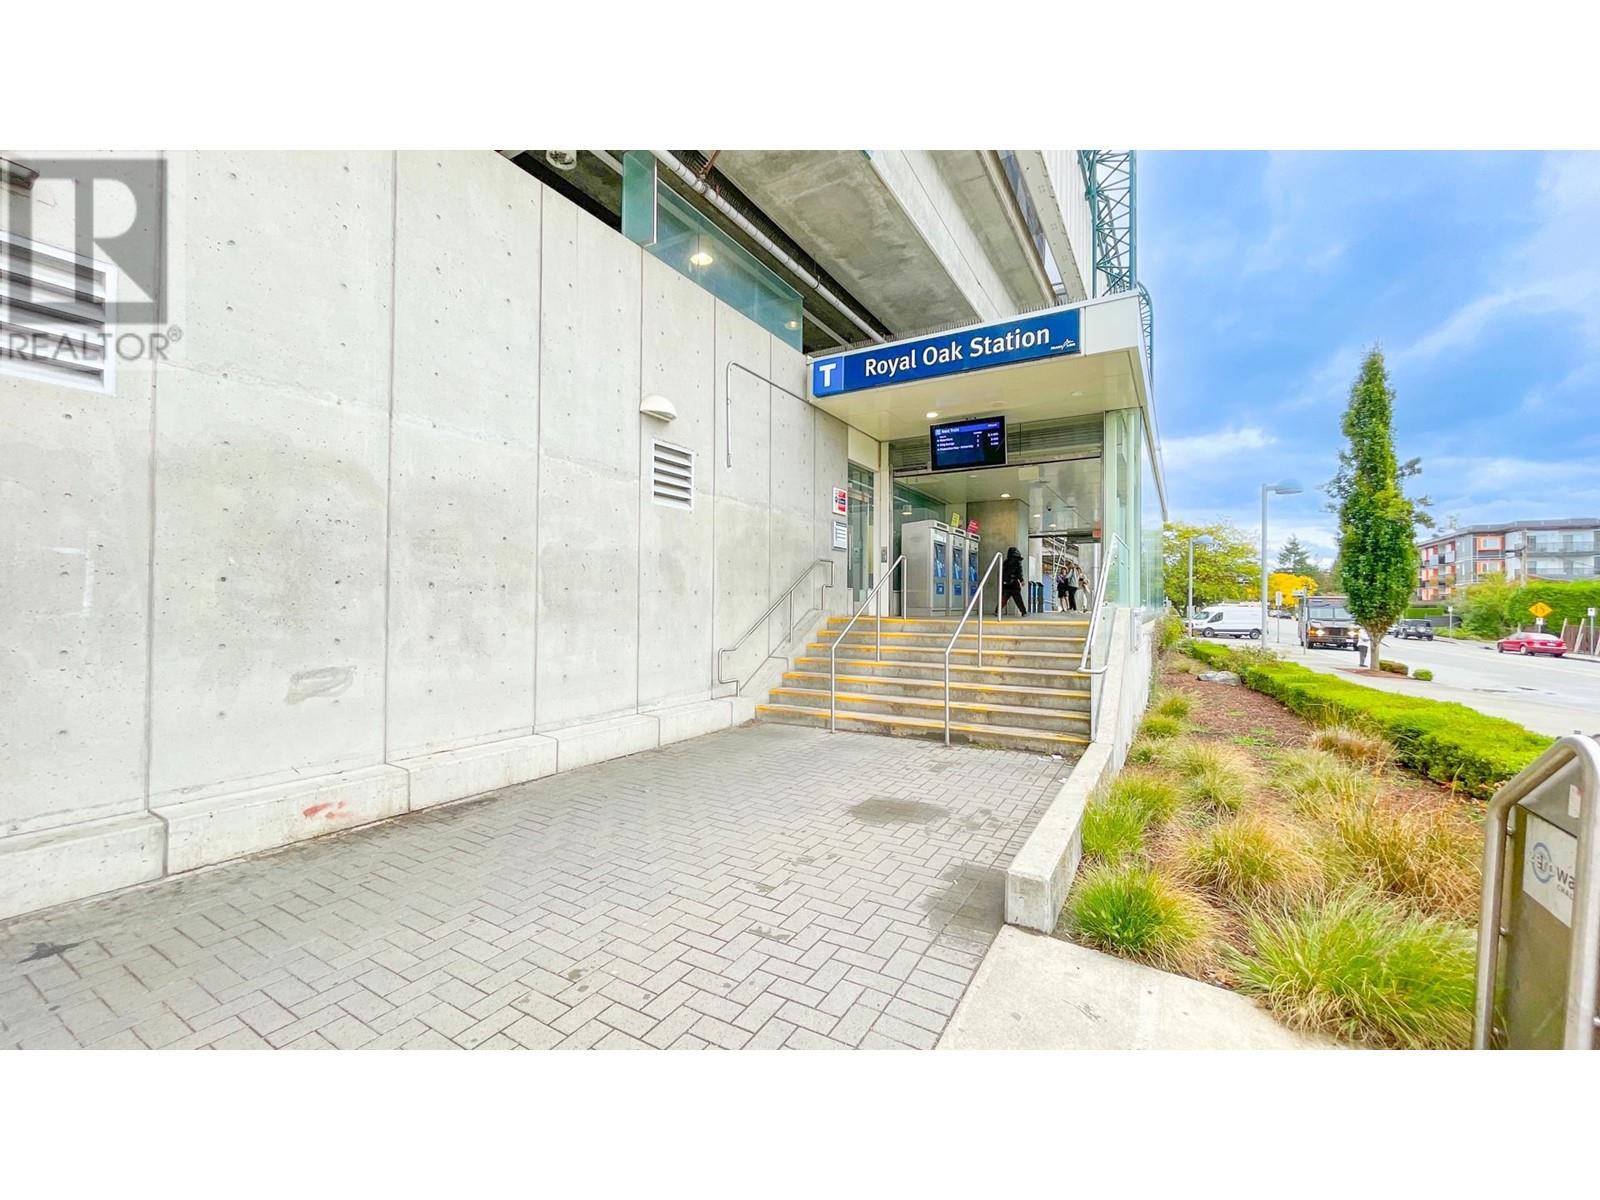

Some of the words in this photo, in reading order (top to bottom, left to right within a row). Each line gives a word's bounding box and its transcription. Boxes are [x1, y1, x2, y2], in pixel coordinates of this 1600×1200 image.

[865, 350, 916, 378] Royal
[922, 341, 963, 366] Oak
[969, 328, 1050, 358] Station
[819, 363, 836, 387] T
